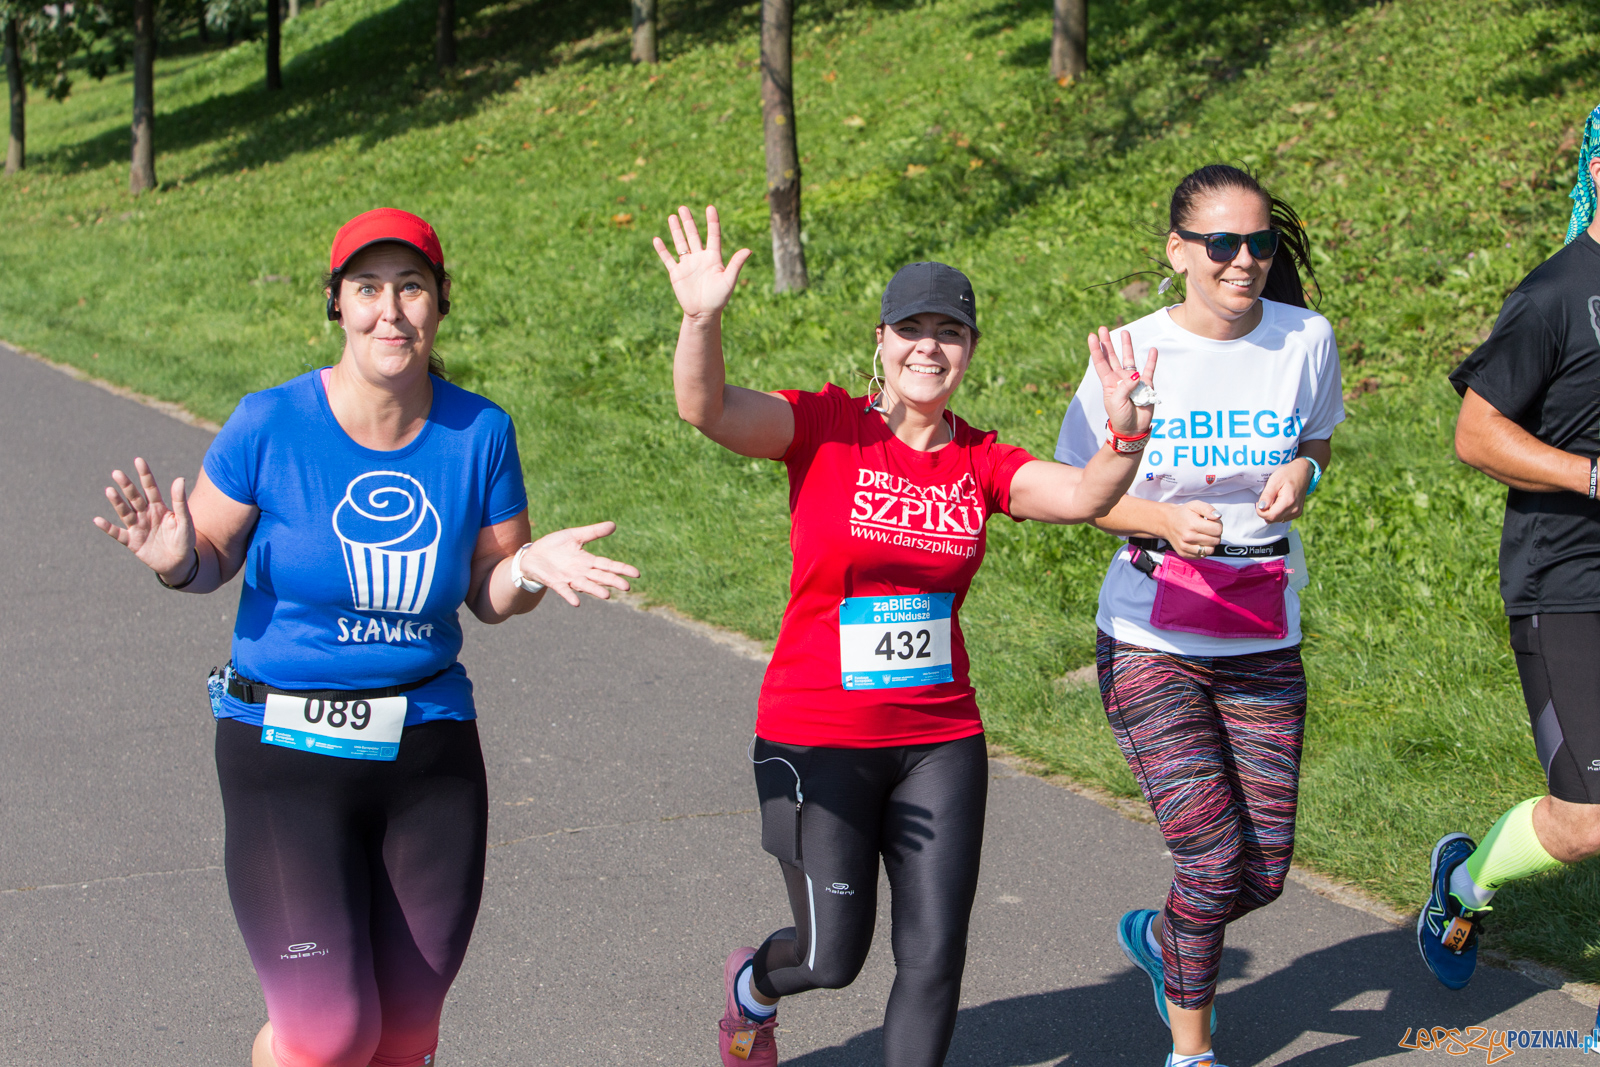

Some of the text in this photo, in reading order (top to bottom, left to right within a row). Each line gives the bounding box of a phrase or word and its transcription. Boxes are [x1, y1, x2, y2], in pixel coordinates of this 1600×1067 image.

[1151, 408, 1304, 442] zaBIEGaj
[1148, 450, 1163, 467] o
[856, 468, 961, 503] DRUŻYNA
[851, 490, 983, 536] SZPIKU
[850, 525, 977, 559] www.darszpiku.pl
[1249, 546, 1274, 555] Kalenji
[873, 597, 931, 612] zaBIEGaj
[873, 611, 931, 623] o FUNdusze
[875, 629, 931, 661] 432
[304, 699, 371, 730] 089
[825, 886, 855, 896] Kalenji
[280, 948, 329, 959] Kalenji
